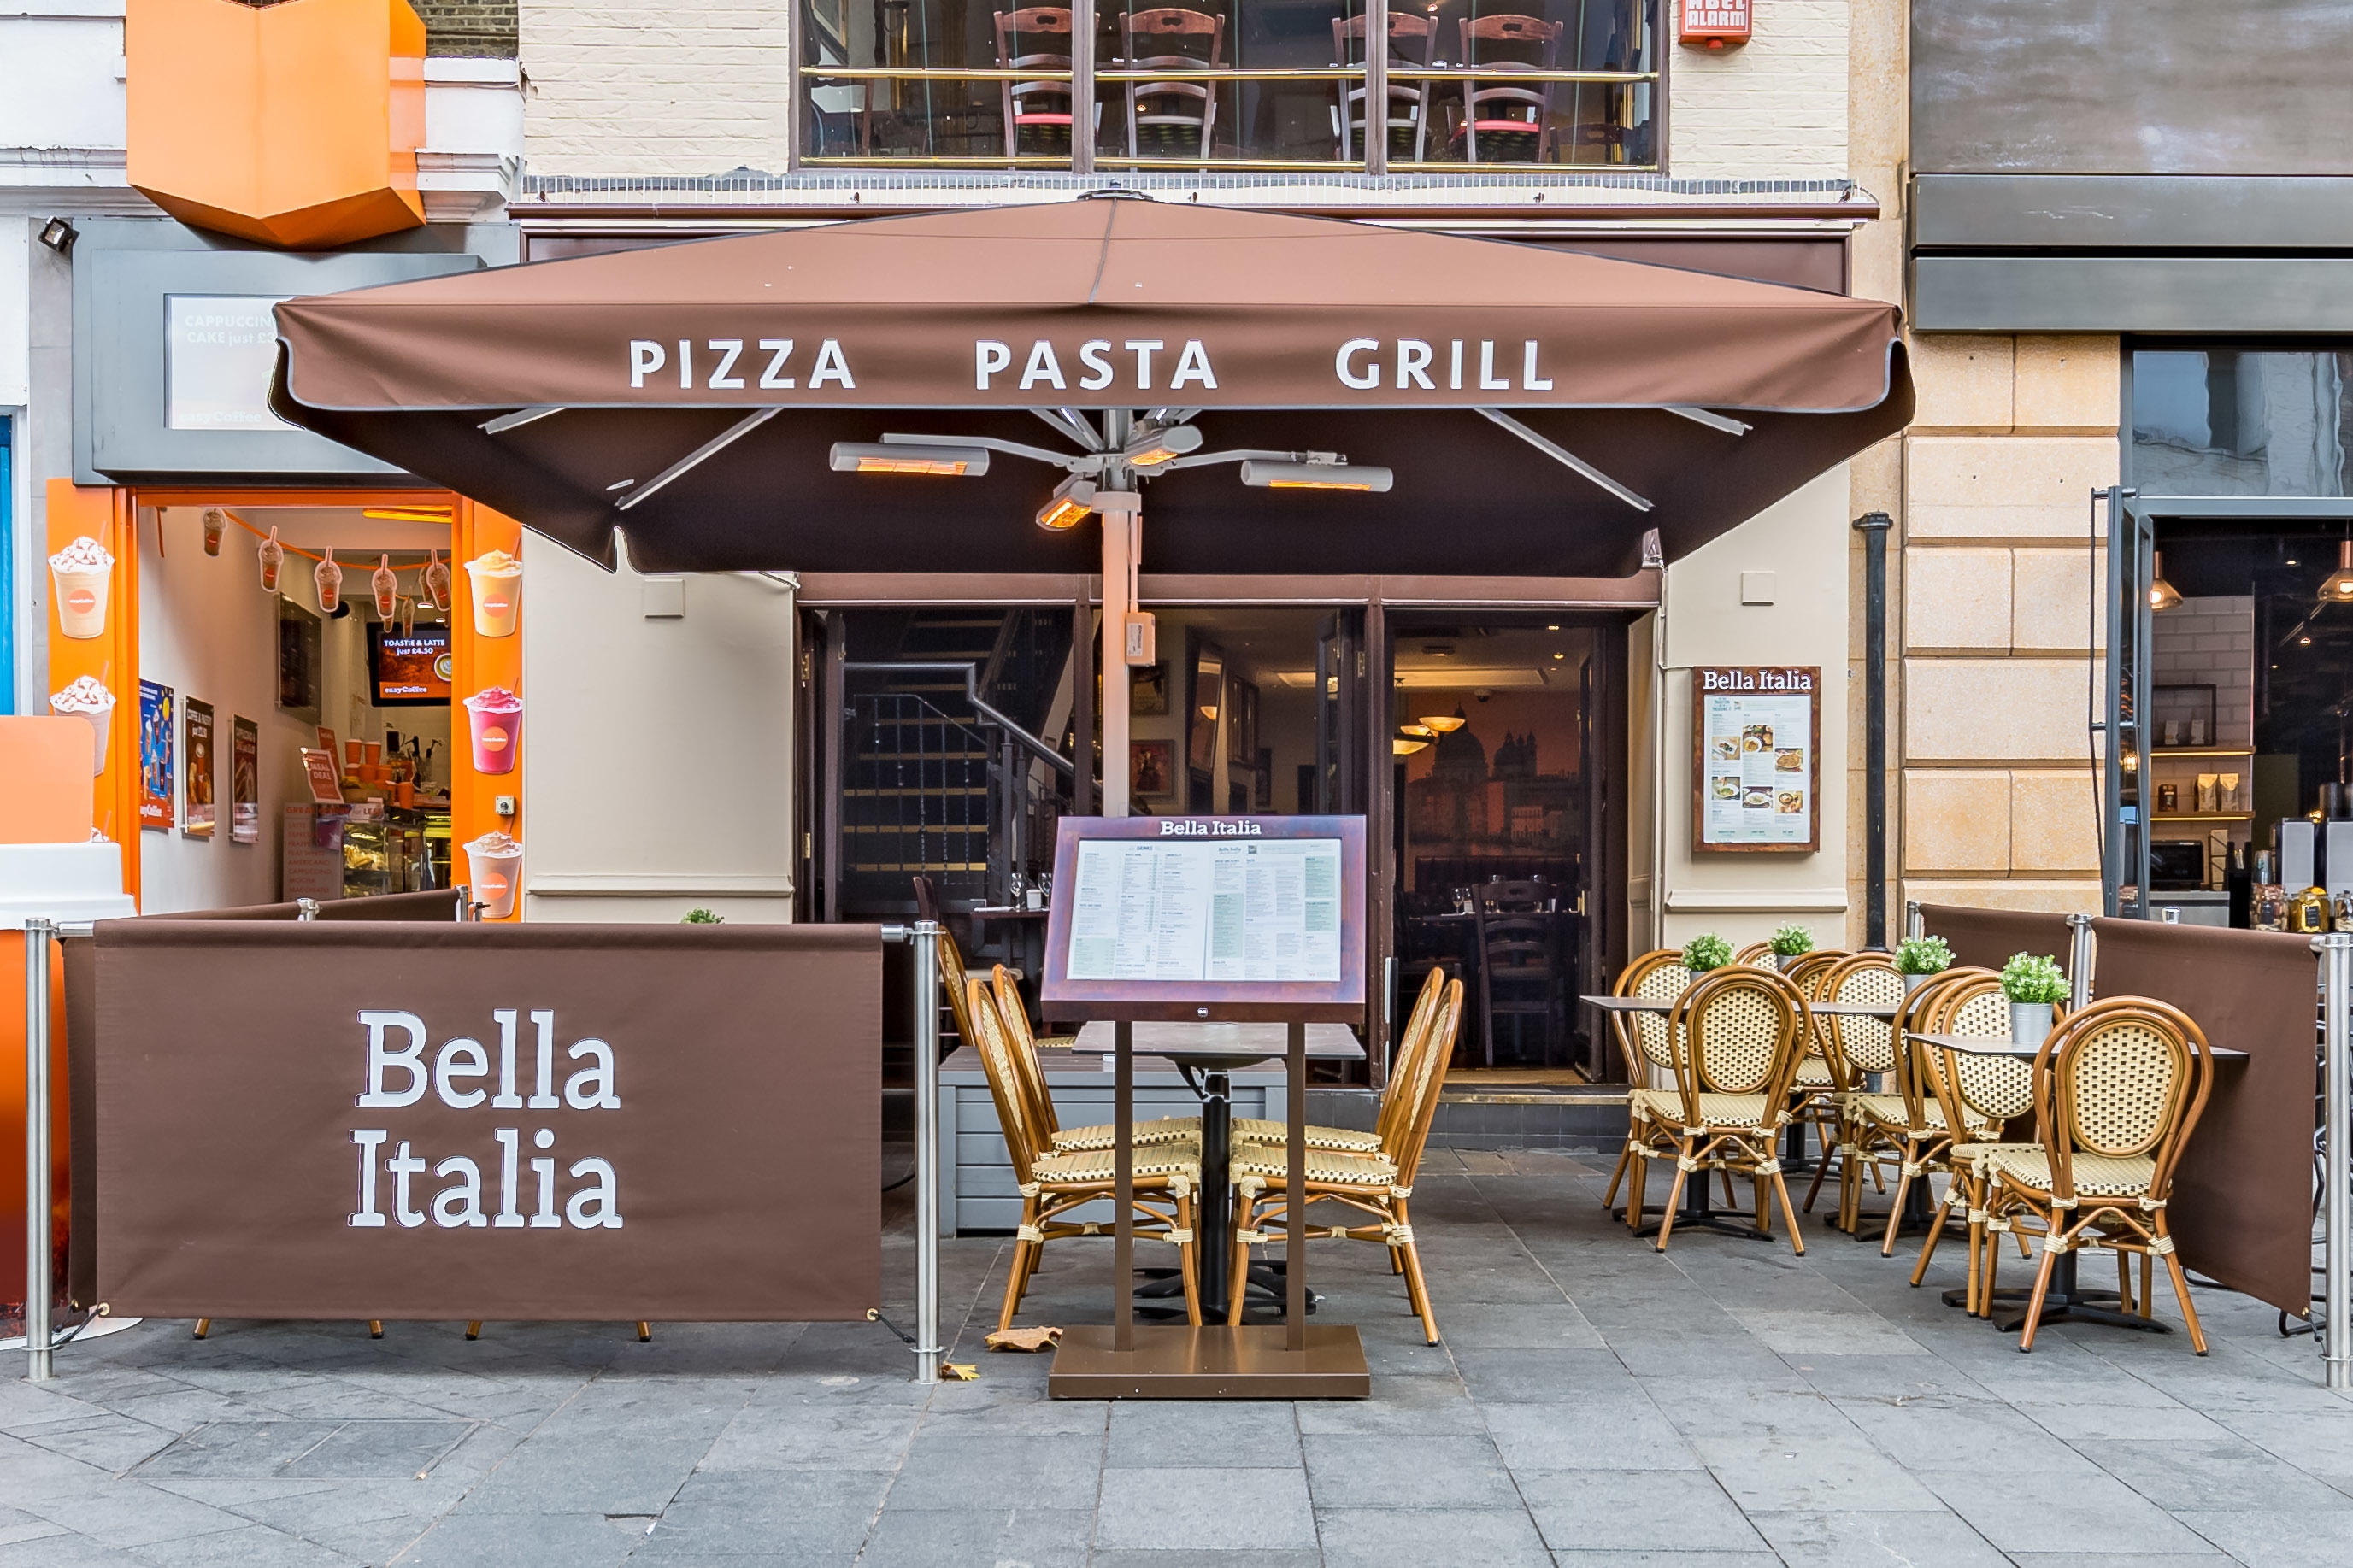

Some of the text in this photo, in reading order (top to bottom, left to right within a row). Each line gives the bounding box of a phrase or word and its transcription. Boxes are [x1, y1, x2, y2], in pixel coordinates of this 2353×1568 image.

[1688, 10, 1745, 26] ALARM
[185, 315, 273, 328] CAPPUCCIN
[186, 332, 274, 347] CAKE just £3
[630, 338, 1553, 391] PIZZA PASTA GRILL
[179, 410, 262, 424] easyCoffee
[397, 648, 410, 656] just
[1703, 670, 1812, 690] Bella Italia
[310, 762, 331, 772] MEAL
[313, 772, 332, 780] DEAL
[1160, 820, 1262, 836] Bella Italia
[355, 1009, 621, 1110] Bella
[348, 1127, 624, 1230] Italia
